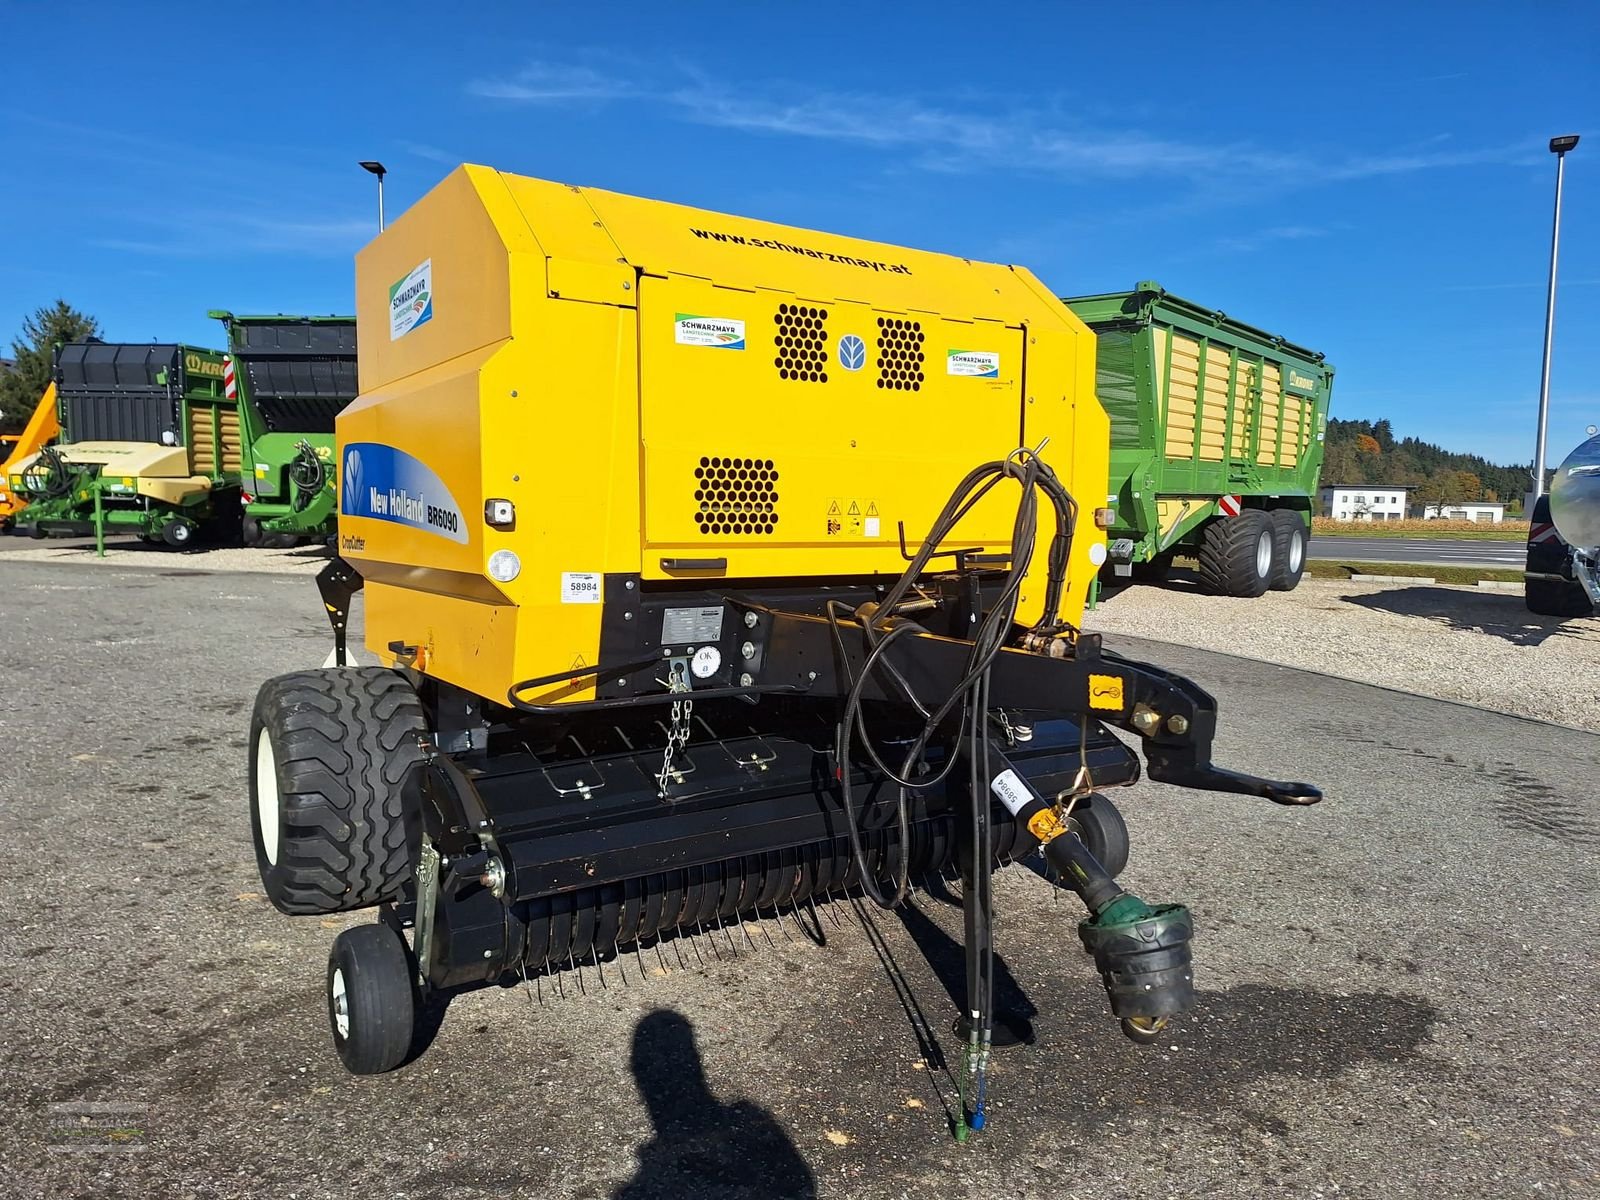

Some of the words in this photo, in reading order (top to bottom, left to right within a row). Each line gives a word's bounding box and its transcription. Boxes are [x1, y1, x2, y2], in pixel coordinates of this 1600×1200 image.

[690, 228, 913, 276] www.schwarzmayr.at
[393, 278, 426, 310] SCHWARZMAYR
[681, 320, 736, 333] SCHWARZMAYR
[952, 355, 992, 364] SCHWARZMAYR
[370, 486, 388, 515] New
[389, 488, 424, 523] Holland
[427, 505, 458, 533] BR6090
[342, 534, 366, 552] CropCutter
[570, 582, 597, 591] 58984
[700, 652, 712, 660] OK
[997, 779, 1018, 803] 58984
